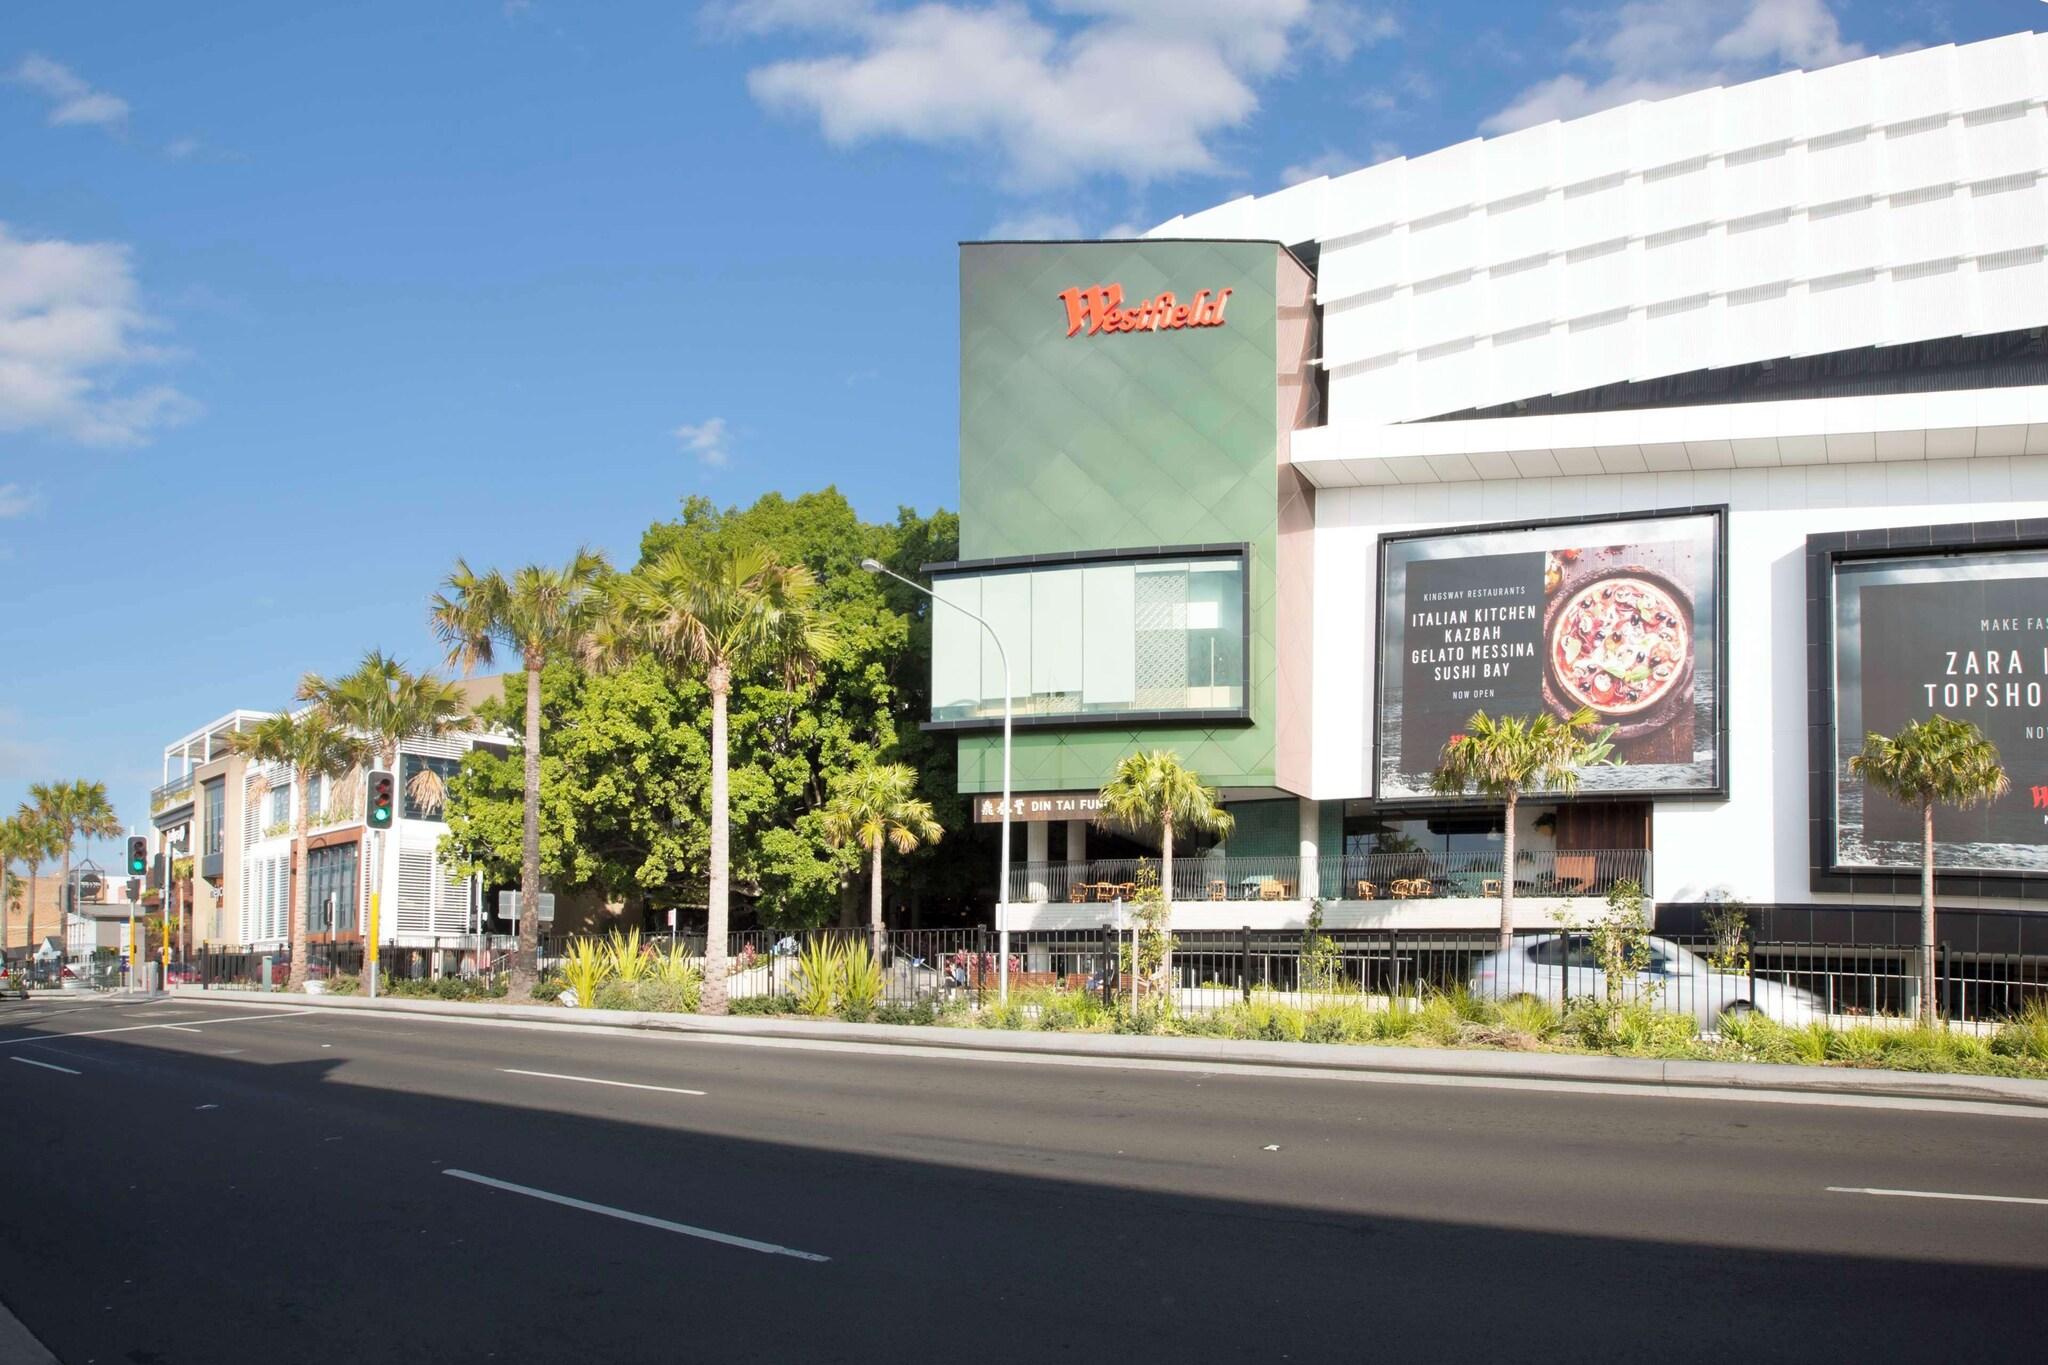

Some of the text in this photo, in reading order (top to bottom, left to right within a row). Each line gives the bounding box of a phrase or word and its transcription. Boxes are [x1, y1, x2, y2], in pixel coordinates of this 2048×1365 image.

[1059, 282, 1233, 338] Westfield
[1423, 586, 1526, 602] KINGSWAY RESTAURANTS
[1412, 604, 1537, 628] ITALIAN KITCHEN
[1980, 618, 2020, 632] MAKE
[1444, 625, 1501, 644] KAZBAH
[1411, 642, 1535, 665] GELATO MESSINA
[1945, 649, 2023, 676] ZARA
[1434, 662, 1511, 682] SUSHI BAY
[1452, 688, 1495, 701] NOW OPEN
[2025, 726, 2048, 739] NO
[1031, 800, 1052, 812] DIN
[1055, 799, 1075, 811] TAI
